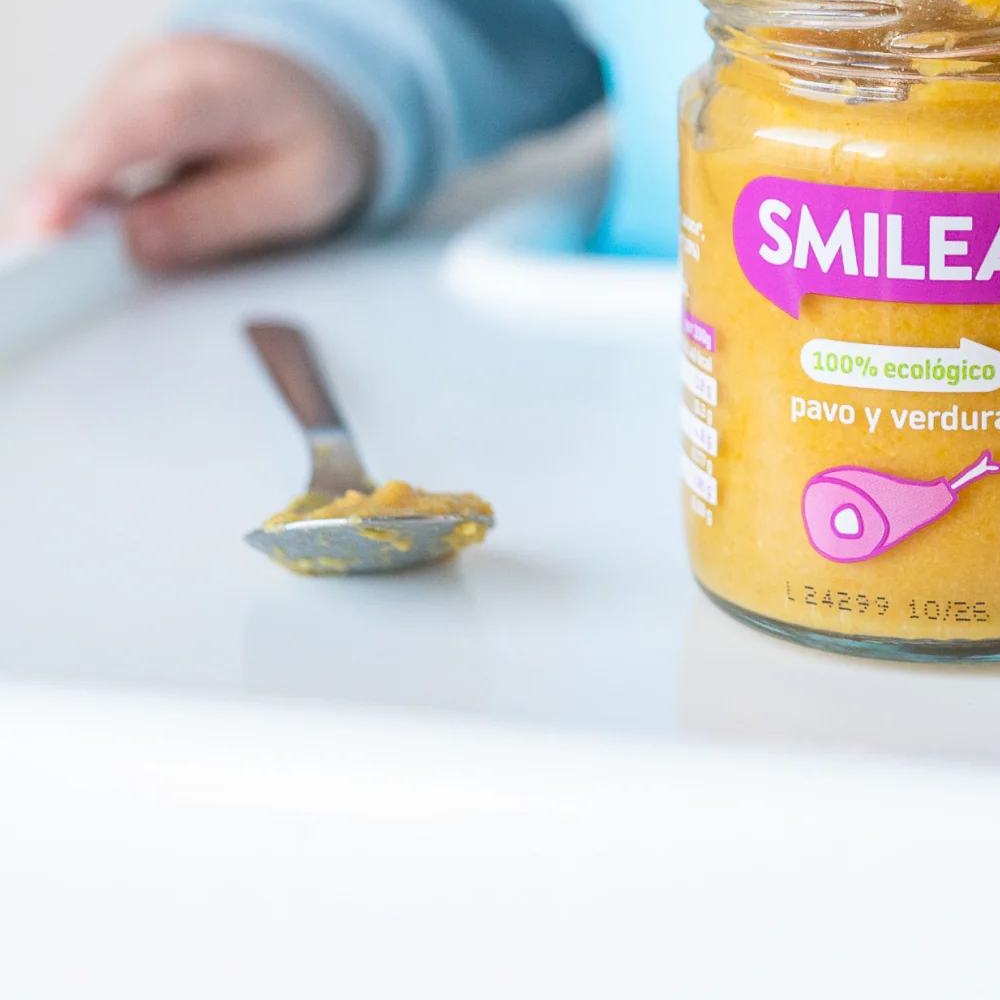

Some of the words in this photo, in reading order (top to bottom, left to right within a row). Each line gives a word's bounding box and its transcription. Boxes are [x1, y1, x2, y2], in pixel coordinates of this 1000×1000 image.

[812, 351, 878, 377] 100%
[883, 357, 996, 386] ecológico
[790, 395, 856, 425] pavo
[864, 406, 882, 433] y
